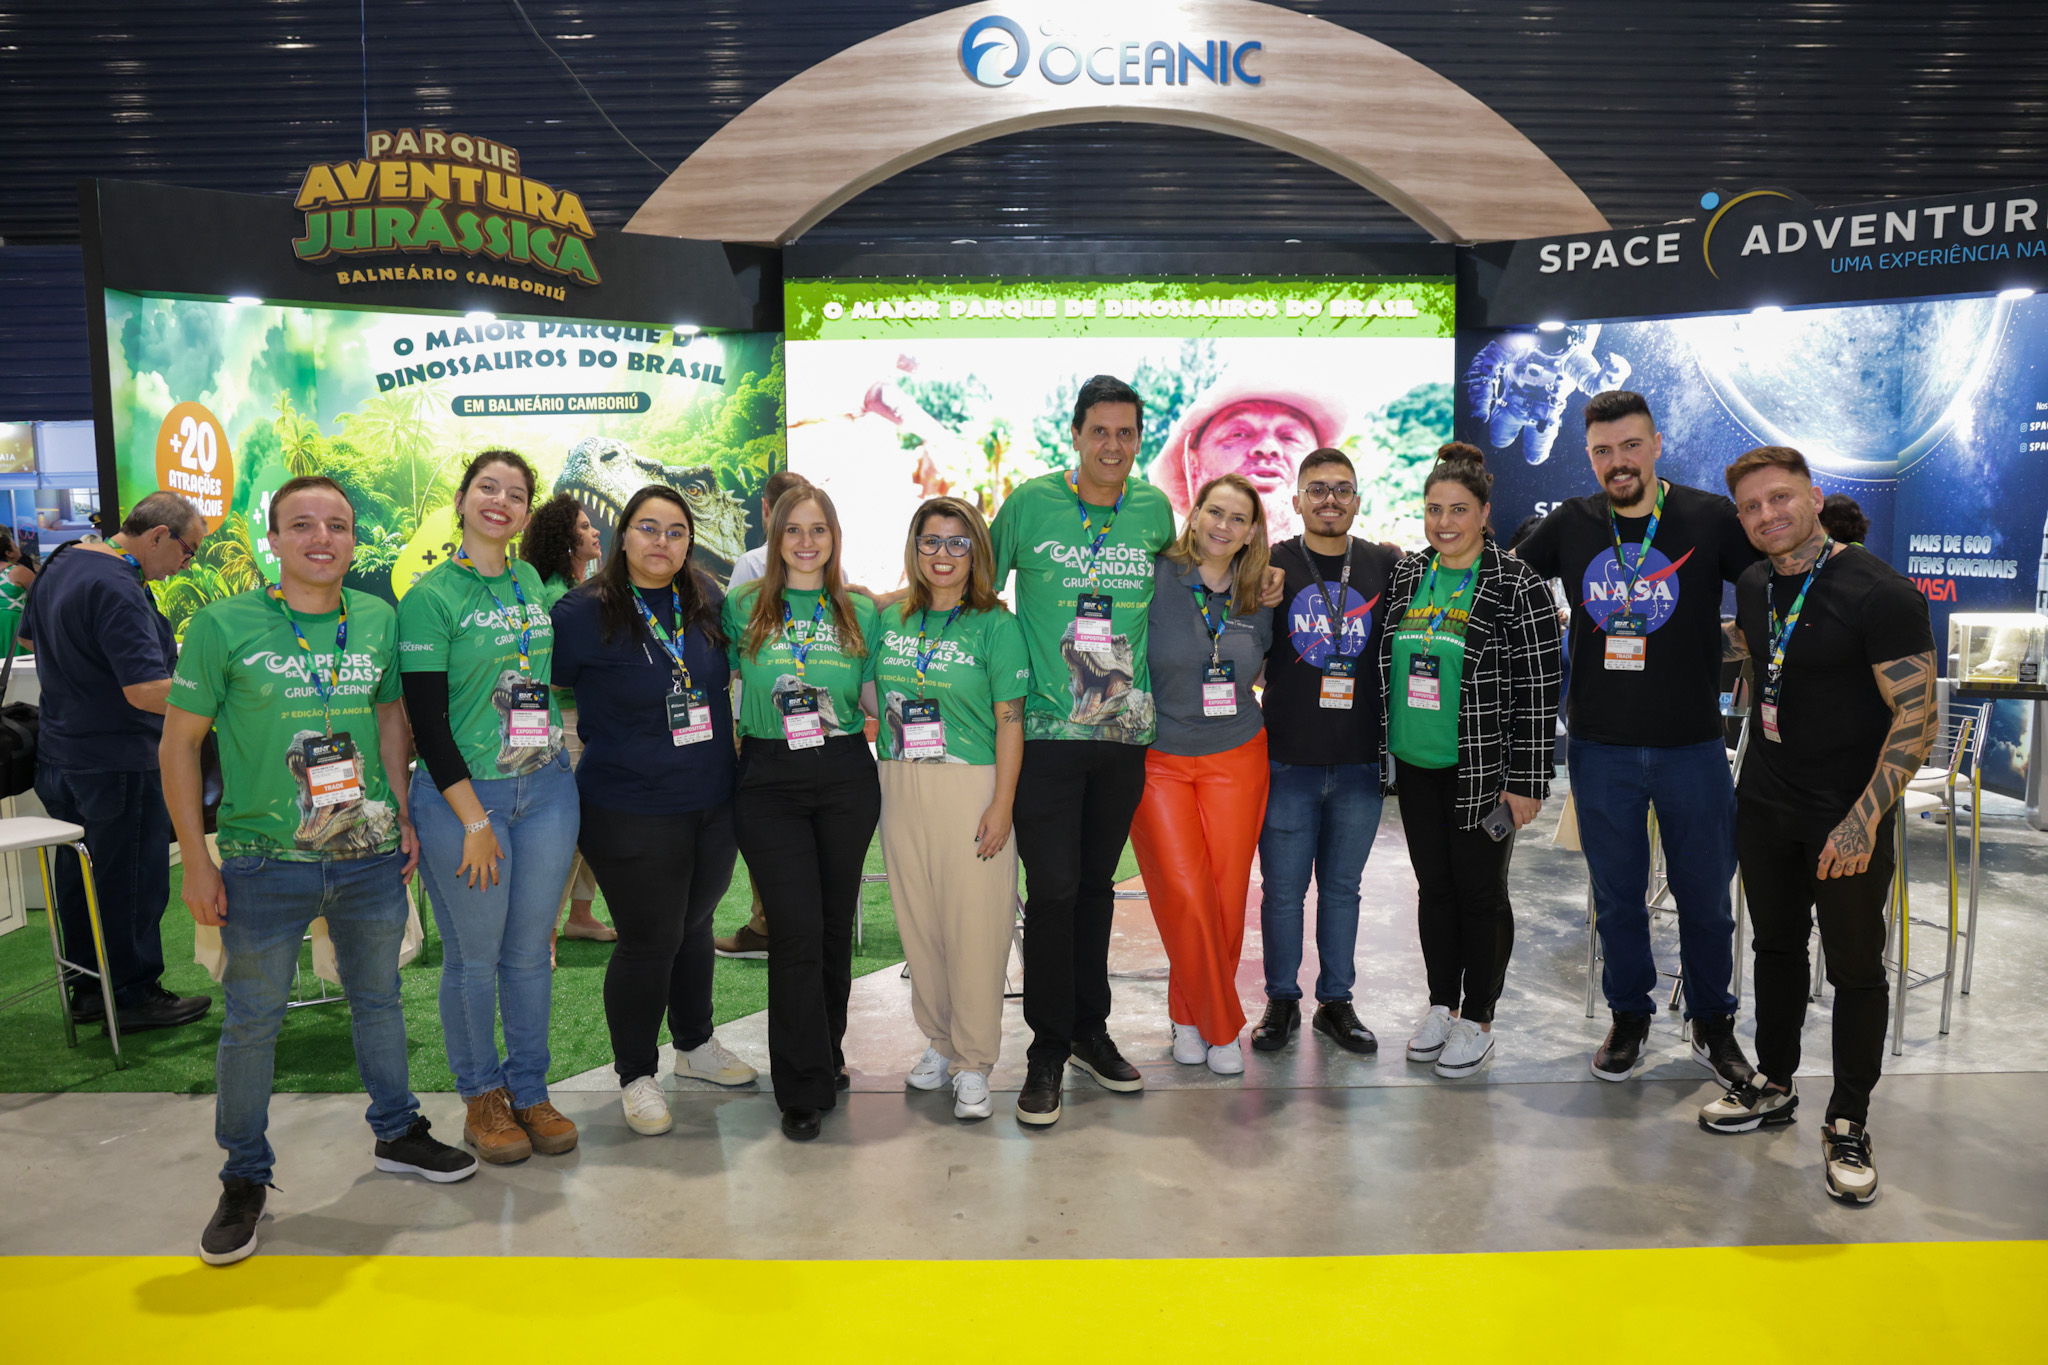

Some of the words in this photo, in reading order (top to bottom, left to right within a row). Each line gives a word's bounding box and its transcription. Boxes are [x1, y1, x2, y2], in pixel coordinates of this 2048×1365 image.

[1039, 40, 1262, 85] OCEANIC
[370, 131, 517, 173] PARQUE
[296, 159, 597, 238] AVENTURA
[295, 198, 600, 282] JURÁSSICA
[1539, 232, 1681, 274] SPACE
[1740, 198, 2048, 257] ADVENTUR
[1831, 255, 1873, 274] UMA
[1879, 243, 2010, 270] EXPERIÊNCIA
[337, 264, 458, 285] BALNEÁRIO
[466, 270, 566, 302] CAMBORIÚ
[823, 301, 844, 320] O
[851, 300, 940, 319] MAIOR
[950, 299, 1057, 321] PARQUE
[1065, 299, 1097, 318] DE
[1105, 299, 1278, 318] DINOSSAUROS
[1286, 299, 1323, 318] DO
[1330, 299, 1419, 318] BRASIL
[393, 337, 415, 356] O
[426, 320, 526, 351] MAIOR
[538, 321, 661, 343] PARQUE
[375, 349, 567, 393] DINOSSAUROS
[579, 349, 618, 368] DO
[628, 352, 727, 386] BRASIL
[464, 399, 485, 413] EM
[488, 394, 565, 412] BALNEÁRIO
[568, 392, 639, 411] CAMBORIÚ
[2030, 421, 2048, 431] SPA
[2029, 441, 2048, 452] SPA
[168, 469, 222, 499] ATRAÇÕES
[1909, 534, 1941, 552] MAIS
[1943, 535, 1962, 553] DE
[1963, 535, 1992, 554] 600
[1908, 556, 1945, 575] ITENS
[1946, 558, 2018, 579] ORIGINAIS
[1063, 578, 1100, 589] GRUPO
[1102, 578, 1144, 590] OCEANIC
[1589, 580, 1674, 601] NASA
[495, 633, 518, 646] GRUP
[883, 657, 910, 666] GRUPO
[291, 708, 324, 718] EDIÇÃO
[679, 725, 706, 734] EXPOSITOR
[324, 782, 345, 792] TRADE
